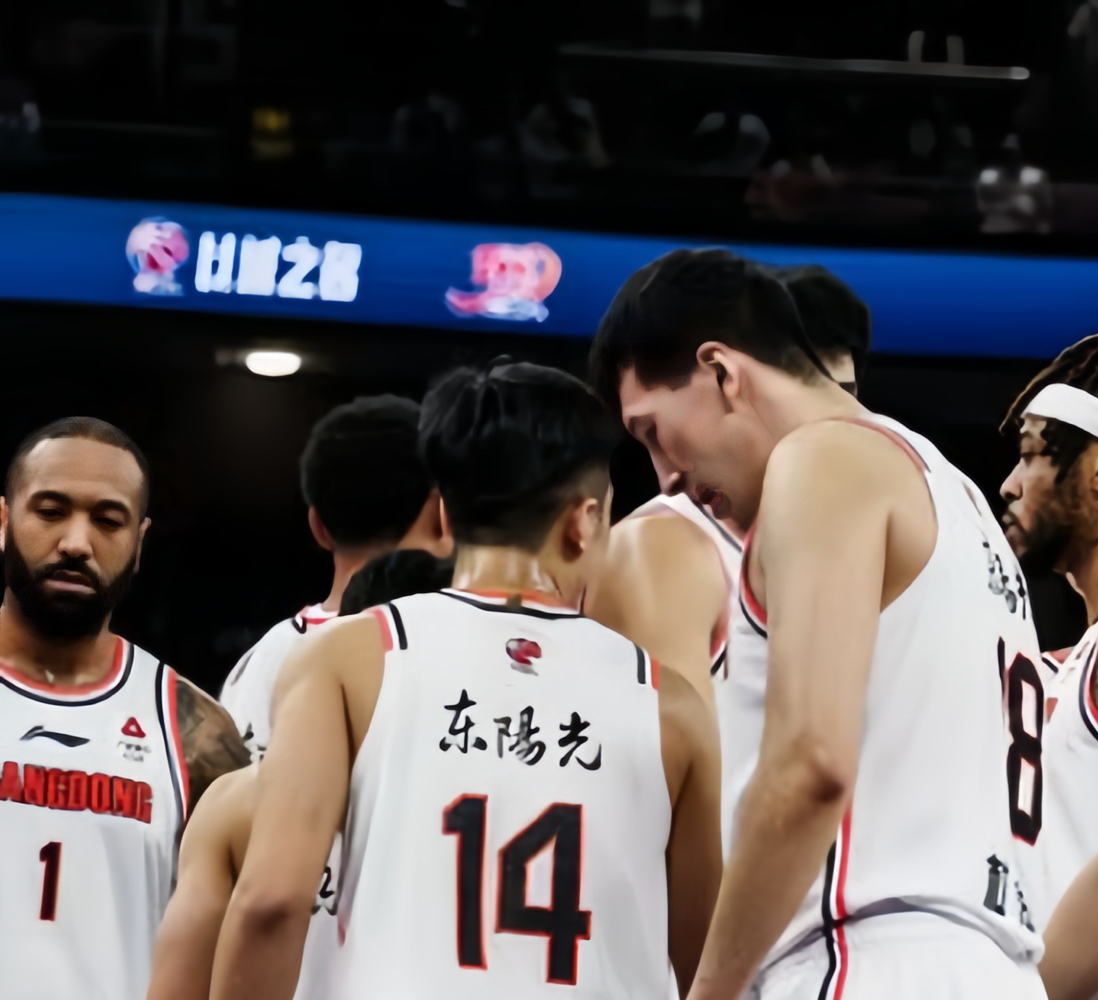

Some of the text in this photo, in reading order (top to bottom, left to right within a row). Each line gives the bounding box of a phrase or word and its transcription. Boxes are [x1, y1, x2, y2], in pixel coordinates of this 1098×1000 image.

[998, 636, 1044, 847] 8
[39, 841, 62, 922] 1
[441, 793, 592, 986] 14
